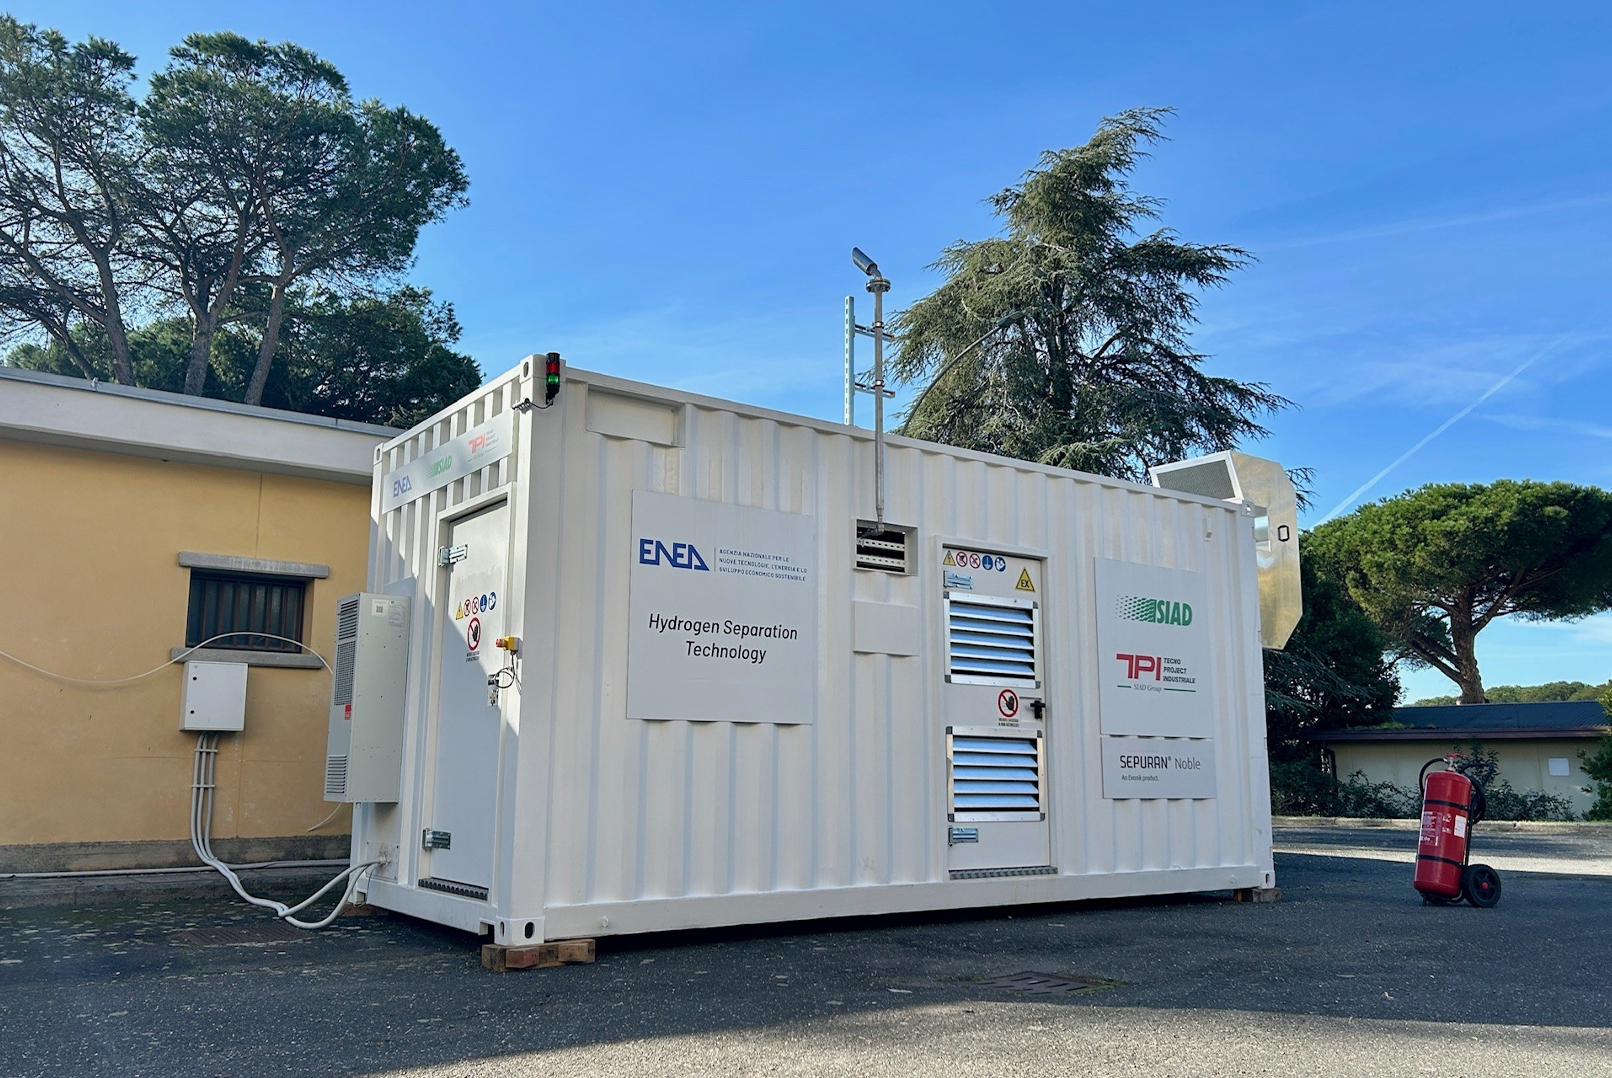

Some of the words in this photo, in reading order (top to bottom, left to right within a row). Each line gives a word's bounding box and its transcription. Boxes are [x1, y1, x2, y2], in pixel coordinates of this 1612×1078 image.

[468, 433, 486, 454] TPI
[393, 475, 412, 498] ENEA
[639, 538, 711, 572] ENEA
[742, 552, 771, 561] NAZIONALE
[719, 557, 736, 565] NUOVE
[771, 564, 796, 572] L'ENERGIA
[719, 566, 744, 575] SVILUPPO
[745, 570, 774, 578] ECONOMICO
[775, 573, 806, 581] SOSTENIBILE
[1020, 580, 1030, 588] EX
[1156, 599, 1193, 627] SIAD
[649, 613, 720, 635] Hydrogen
[723, 620, 798, 640] Separation
[685, 640, 767, 664] Technology
[1116, 653, 1162, 681] TPI
[1163, 657, 1181, 665] TECNO
[1163, 666, 1187, 674] PROJECT
[1162, 675, 1196, 684] INDUSTRIALE
[1133, 683, 1147, 691] SIAD
[1147, 684, 1162, 693] Group
[1174, 757, 1201, 770] Noble
